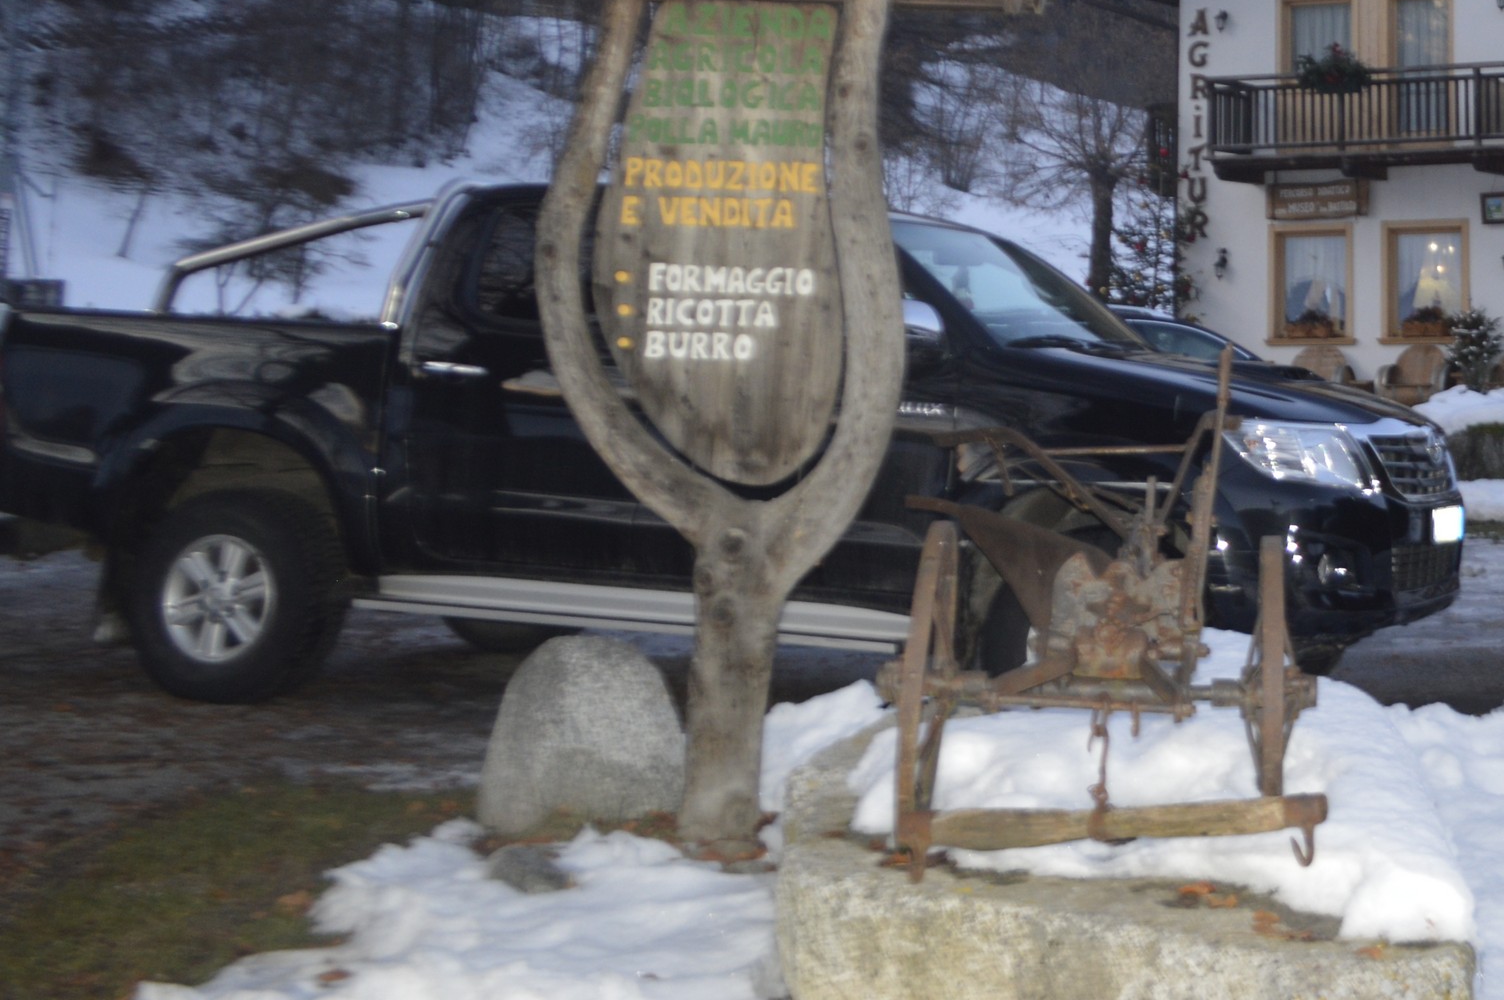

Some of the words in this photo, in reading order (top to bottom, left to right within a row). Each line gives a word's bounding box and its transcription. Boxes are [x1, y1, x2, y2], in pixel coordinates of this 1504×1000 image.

[664, 3, 832, 39] AZIENDA
[649, 40, 824, 76] AGRICOLA
[642, 78, 822, 111] BIOLOGICA
[628, 113, 719, 144] POLLA
[729, 118, 822, 147] MAURO
[624, 157, 820, 193] PRODUZIONE
[621, 196, 638, 225] E
[658, 197, 796, 228] VENDITA
[648, 262, 815, 296] FORMAGGIO
[646, 297, 778, 327] RICOTTA
[644, 330, 755, 360] BURRO
